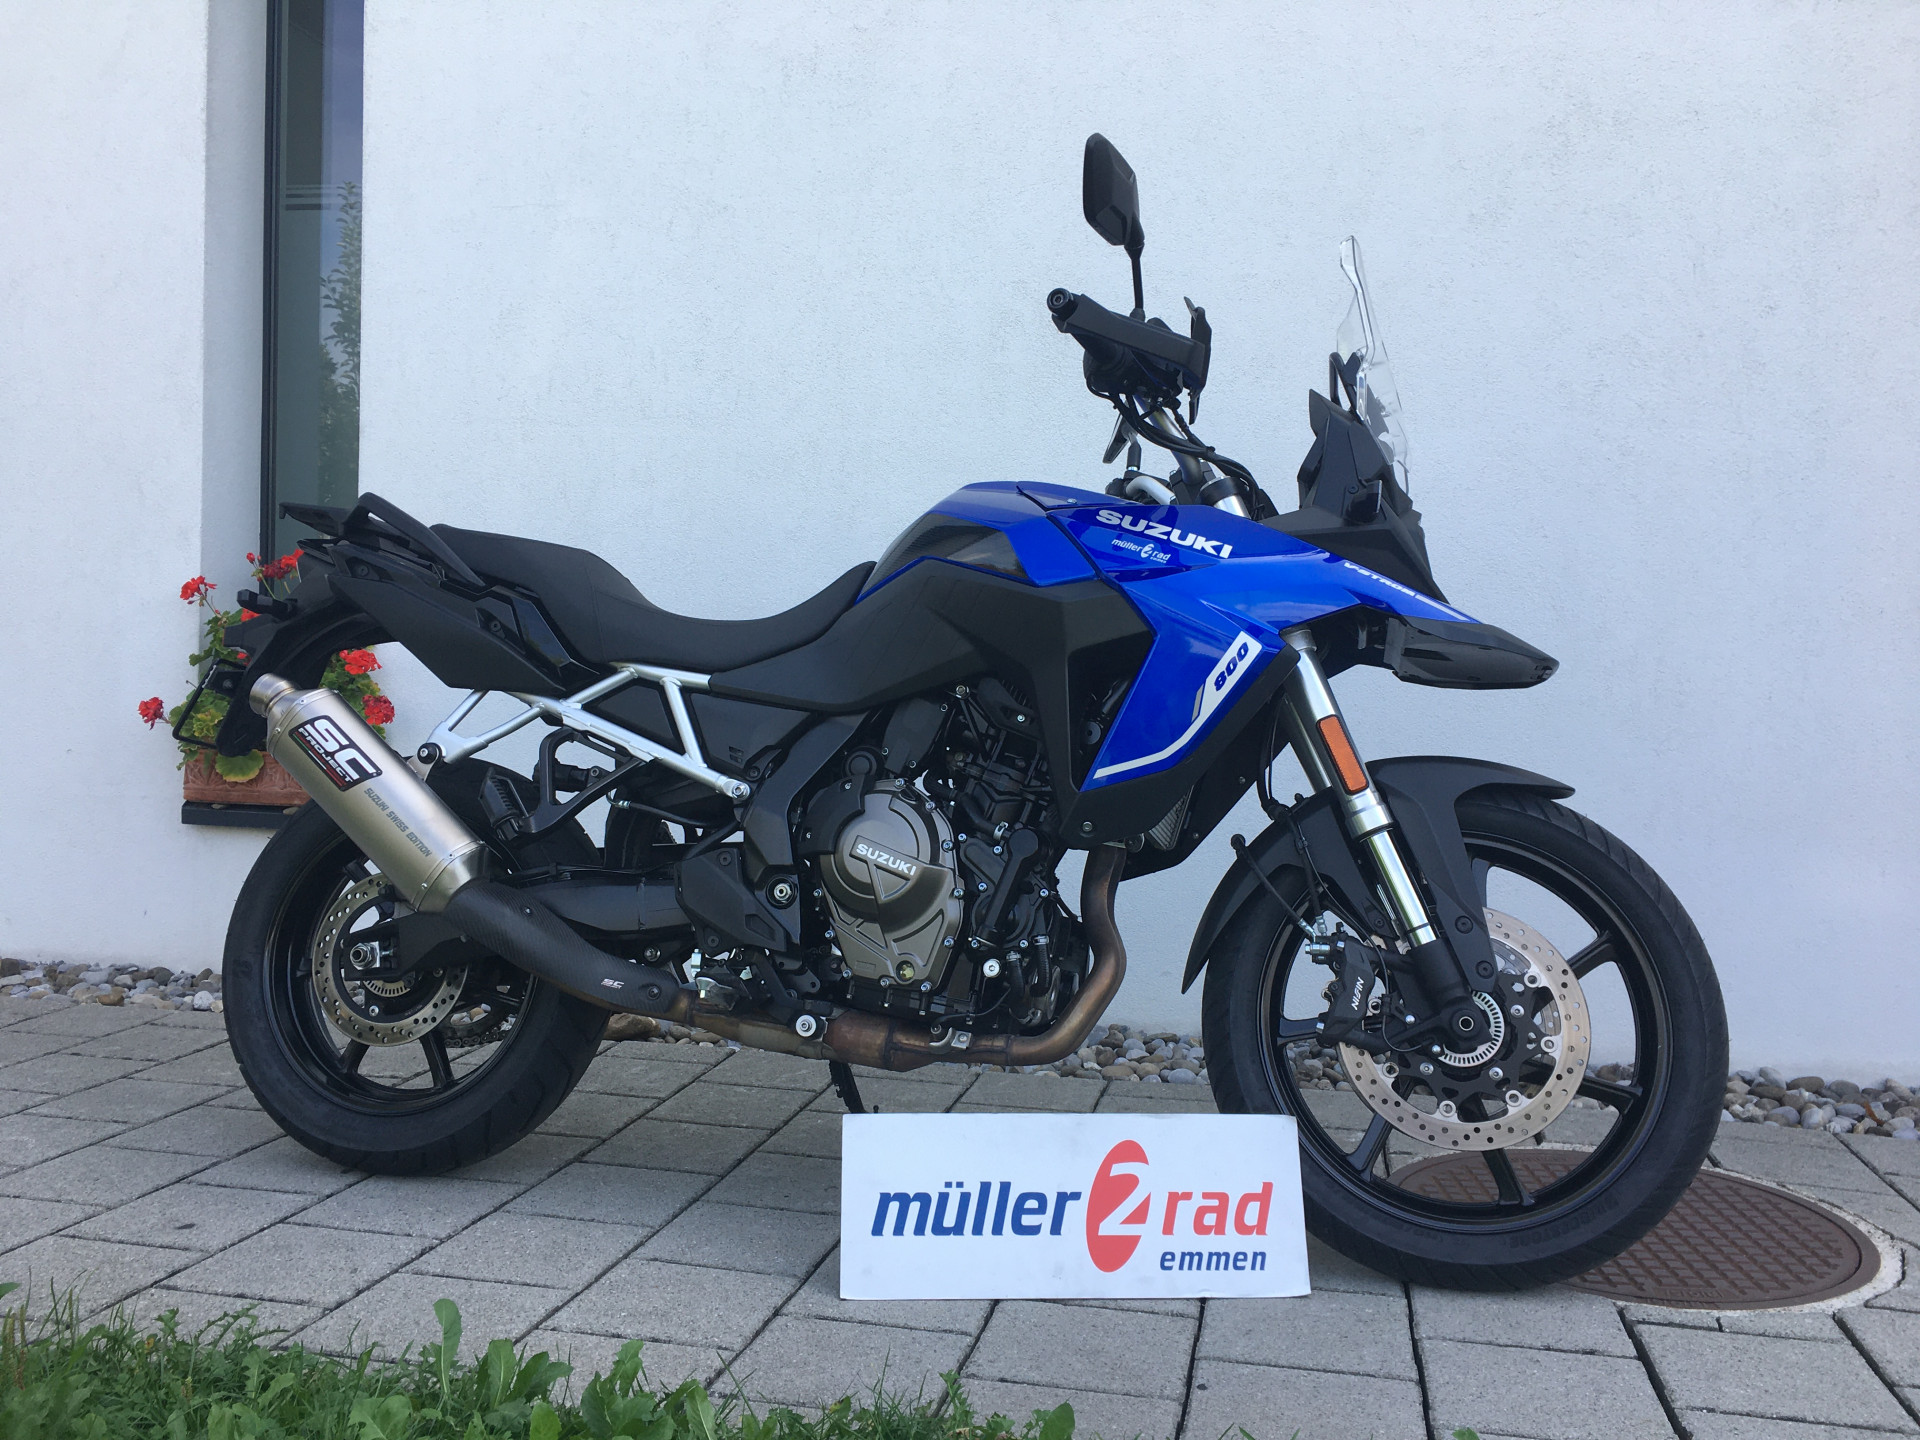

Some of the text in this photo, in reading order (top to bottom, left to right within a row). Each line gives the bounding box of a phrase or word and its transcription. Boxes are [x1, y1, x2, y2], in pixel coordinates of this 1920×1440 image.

[1096, 510, 1233, 559] SUZUKI
[1214, 642, 1249, 692] 800
[298, 728, 353, 782] PROJECT
[304, 719, 377, 780] SC
[364, 787, 433, 857] SUZUKI SWISS EDITION
[856, 844, 917, 876] SUZUKI
[871, 1181, 1082, 1237] müller
[1162, 1181, 1274, 1236] rad
[1159, 1250, 1266, 1271] emmen
